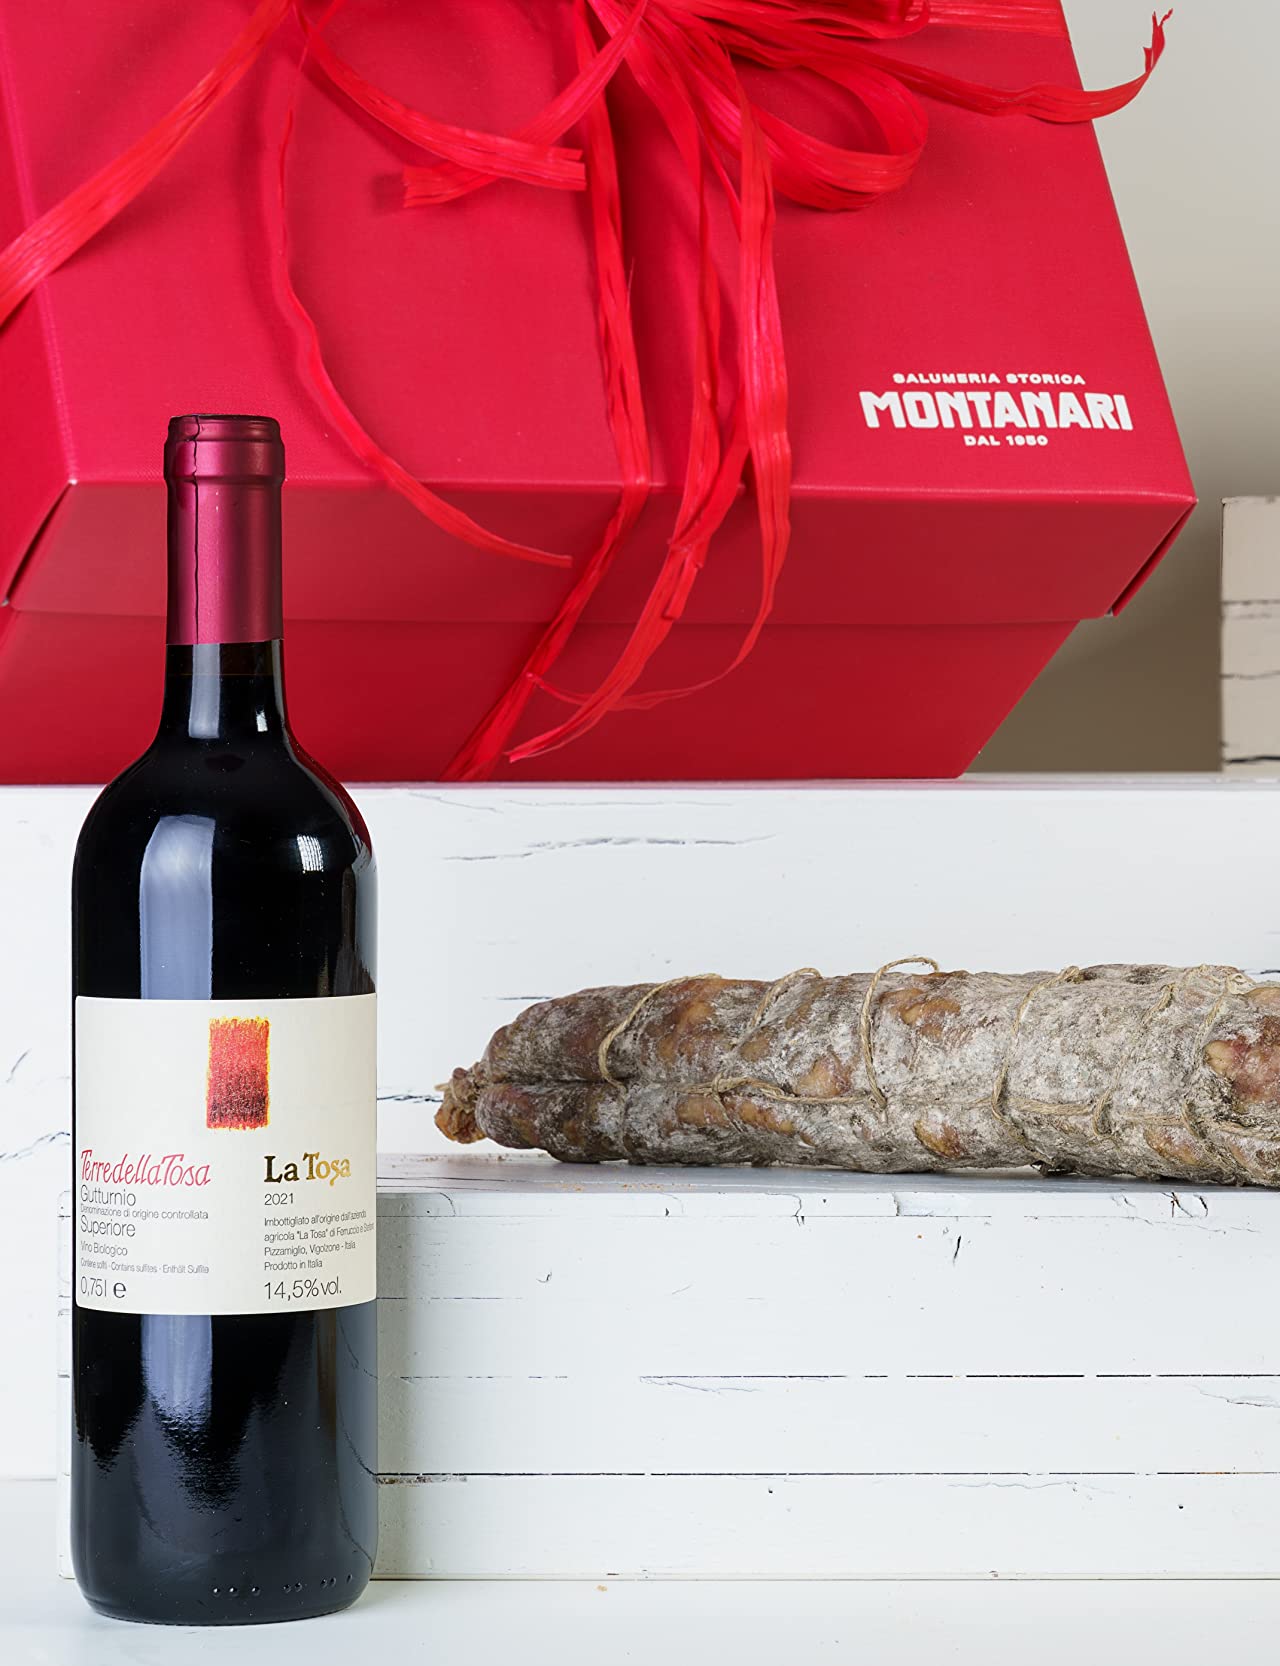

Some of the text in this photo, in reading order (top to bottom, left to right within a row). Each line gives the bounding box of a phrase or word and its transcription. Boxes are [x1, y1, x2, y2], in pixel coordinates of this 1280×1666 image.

[893, 373, 1085, 385] SALUMERIA STORICA
[859, 391, 1133, 430] MONTANARI
[963, 435, 1048, 446] DAL 1950
[264, 1152, 351, 1187] La Tosa
[80, 1184, 136, 1207] Gutturnio
[264, 1193, 293, 1206] 2021
[123, 1208, 130, 1217] di
[132, 1208, 159, 1220] origine
[161, 1209, 208, 1220] controllata
[80, 1214, 136, 1237] Superiore
[264, 1217, 309, 1227] Imbottigliato
[264, 1232, 295, 1243] agricola
[329, 1228, 336, 1237] di
[93, 1242, 128, 1257] Biologico
[264, 1259, 323, 1271] Prodotto in Italia
[113, 1282, 126, 1298] e
[264, 1276, 342, 1301] 14,5% vol.
